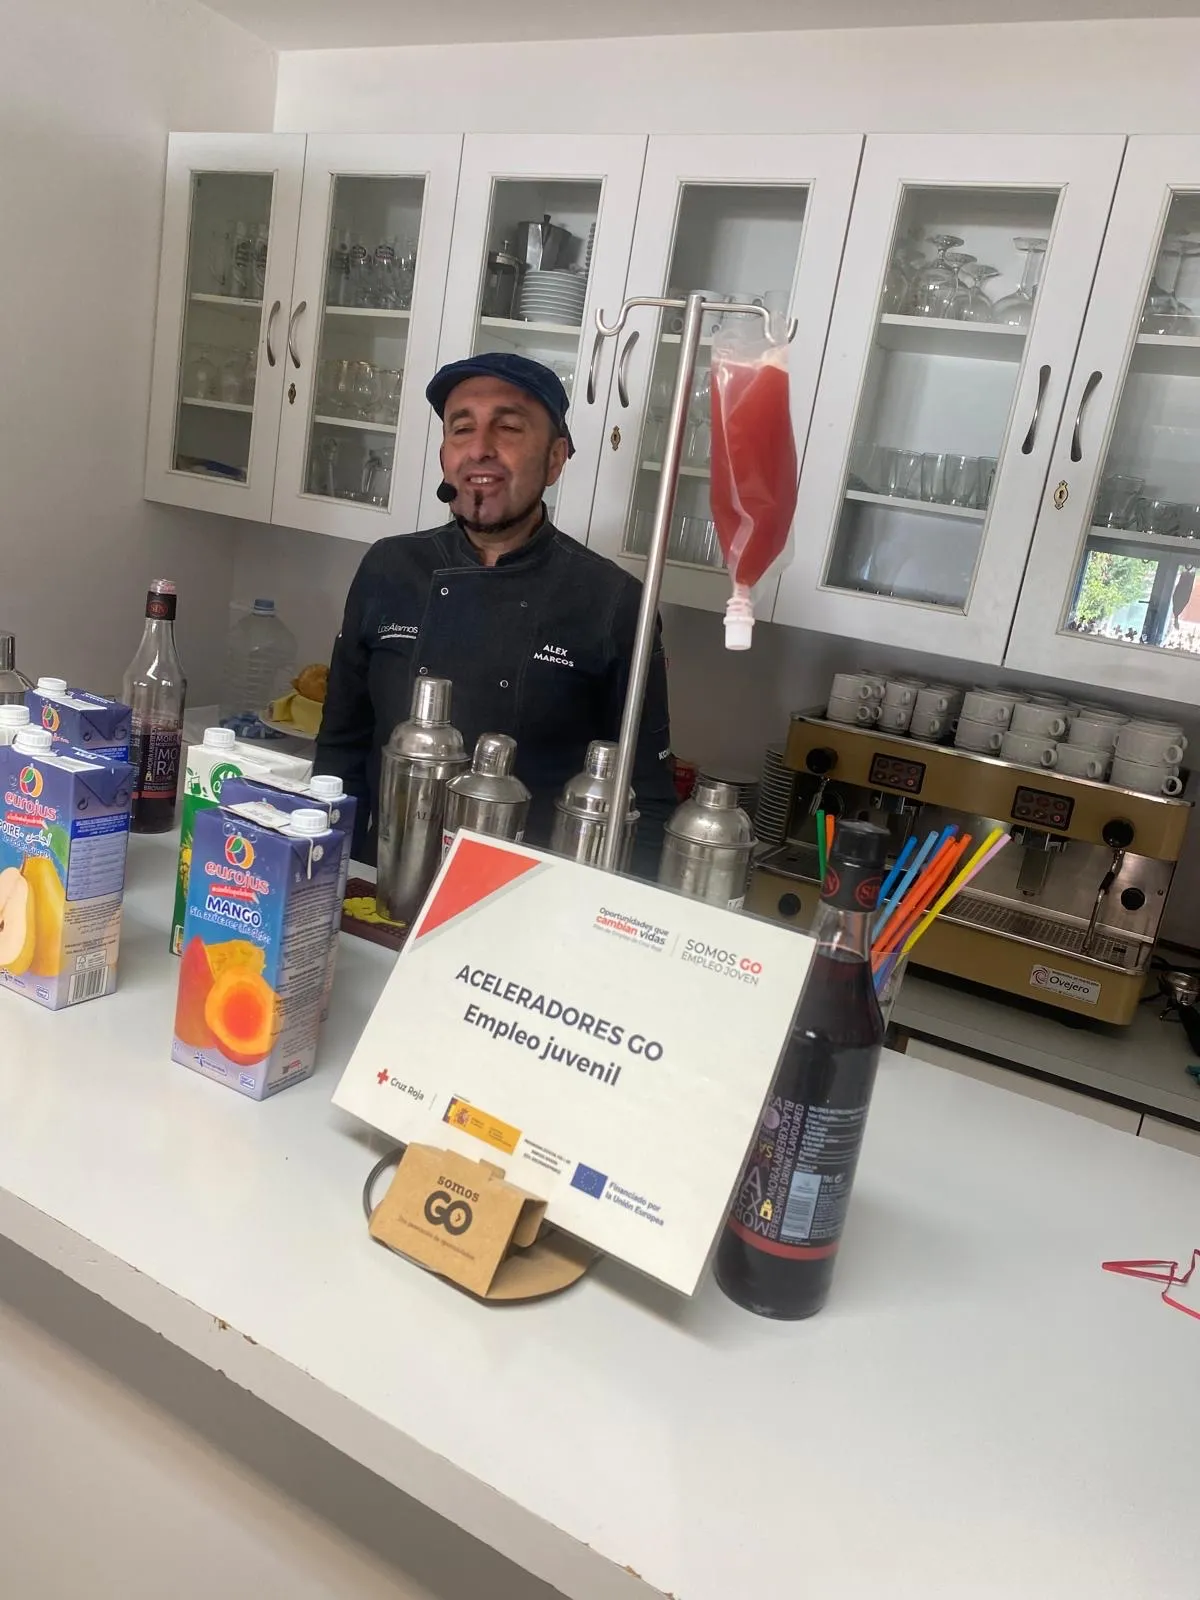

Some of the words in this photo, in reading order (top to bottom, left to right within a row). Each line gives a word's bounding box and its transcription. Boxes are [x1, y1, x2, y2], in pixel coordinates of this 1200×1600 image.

[533, 652, 575, 667] MARCOS
[542, 644, 568, 657] ALEX
[4, 791, 57, 821] eurojus
[204, 861, 270, 895] eurojus
[205, 894, 262, 928] MANGO
[599, 907, 653, 933] Oportunidades
[654, 926, 670, 937] que
[596, 915, 638, 936] cambian
[639, 930, 666, 945] vidas
[680, 951, 723, 973] EMPLEO
[723, 966, 759, 986] JOVEN
[685, 938, 737, 966] SOMOS
[739, 958, 763, 975] GO
[1049, 976, 1090, 994] Ovejero
[455, 964, 625, 1046] ACELERADORES
[627, 1034, 664, 1061] GO
[463, 1003, 541, 1050] Empleo
[538, 1036, 622, 1087] juvenil
[390, 1077, 408, 1092] Cruz
[408, 1087, 425, 1101] Roja
[774, 1099, 795, 1168] BLACKBERRY
[787, 1103, 805, 1159] FLAVOURED
[437, 1175, 480, 1203] somos
[766, 1166, 780, 1200] MORA
[781, 1159, 794, 1188] DRINK
[424, 1190, 473, 1236] GO
[605, 1190, 613, 1201] la
[613, 1194, 634, 1211] Unión
[634, 1206, 665, 1227] Europea
[609, 1181, 647, 1206] Financiado
[647, 1201, 662, 1213] por
[767, 1188, 788, 1240] REFRESHING
